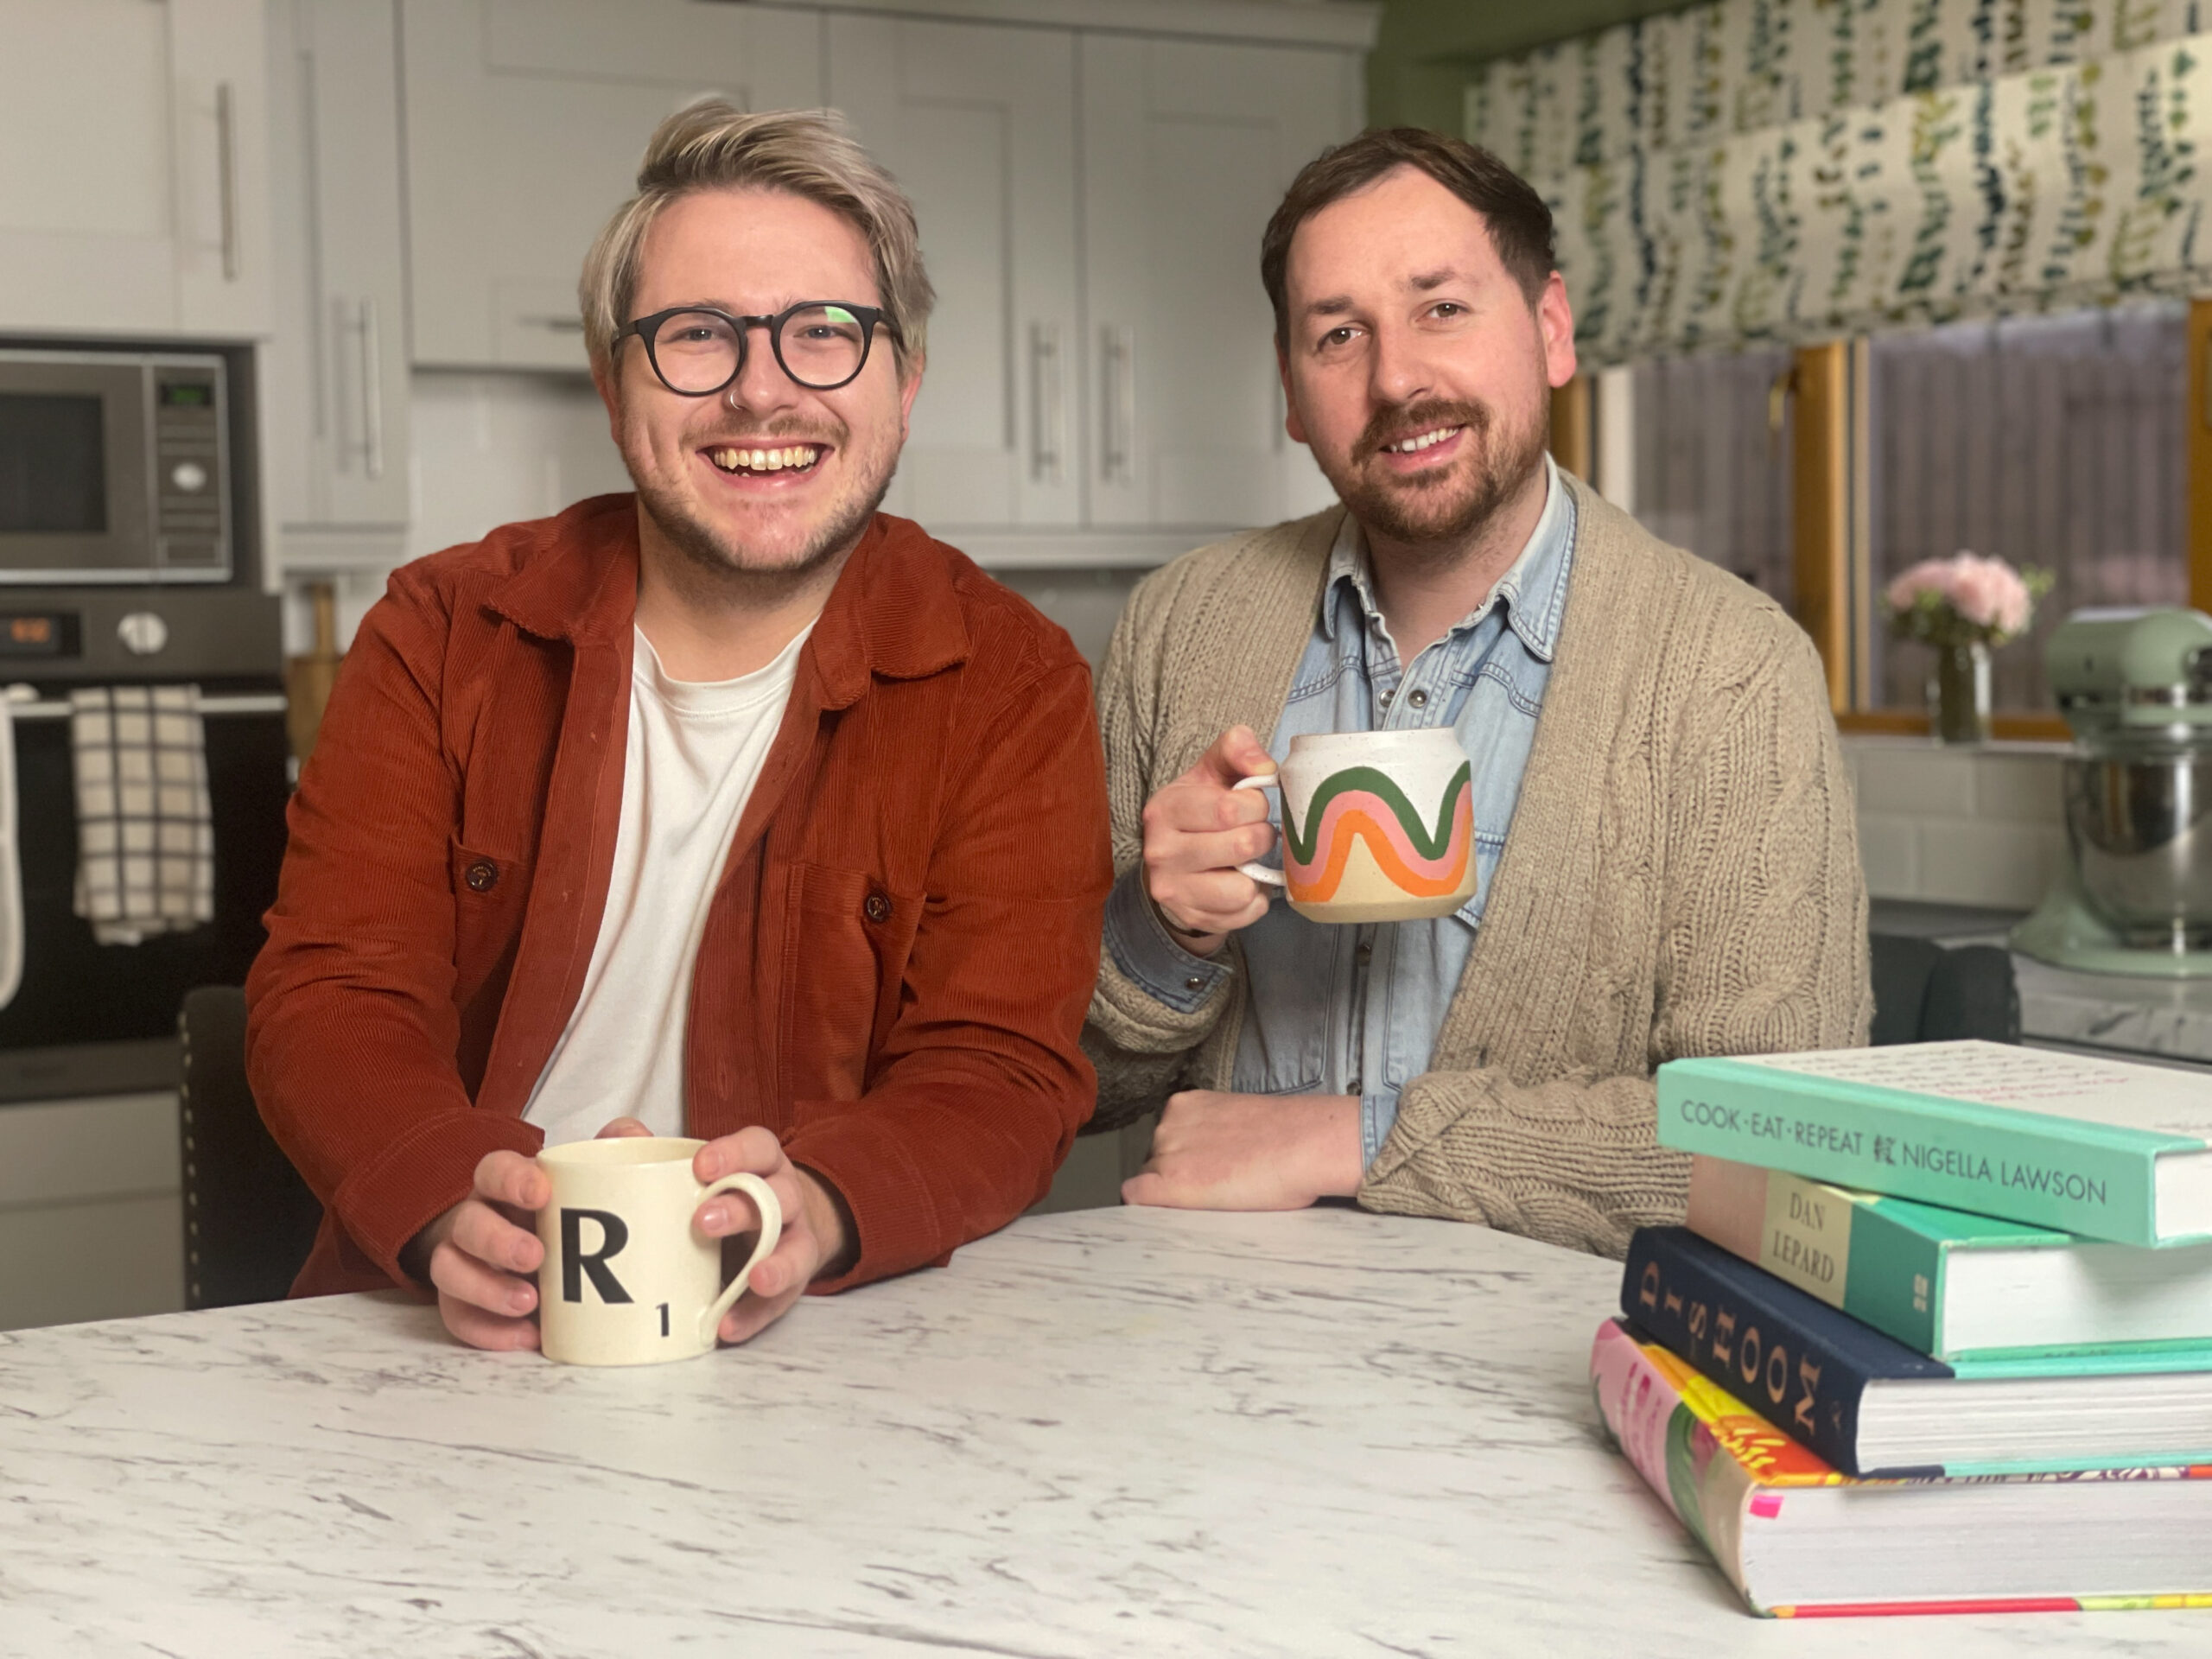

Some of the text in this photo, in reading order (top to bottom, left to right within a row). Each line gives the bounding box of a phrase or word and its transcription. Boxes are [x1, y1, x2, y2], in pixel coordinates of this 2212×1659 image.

[1681, 1100, 2107, 1205] COOK EAT REPEAT NIGELLA LAWSON
[1789, 1192, 1826, 1231] DAN
[560, 1207, 635, 1305] R
[1773, 1230, 1834, 1283] LEPARD
[656, 1302, 670, 1338] 1
[1639, 1260, 1821, 1434] DISHOOM
